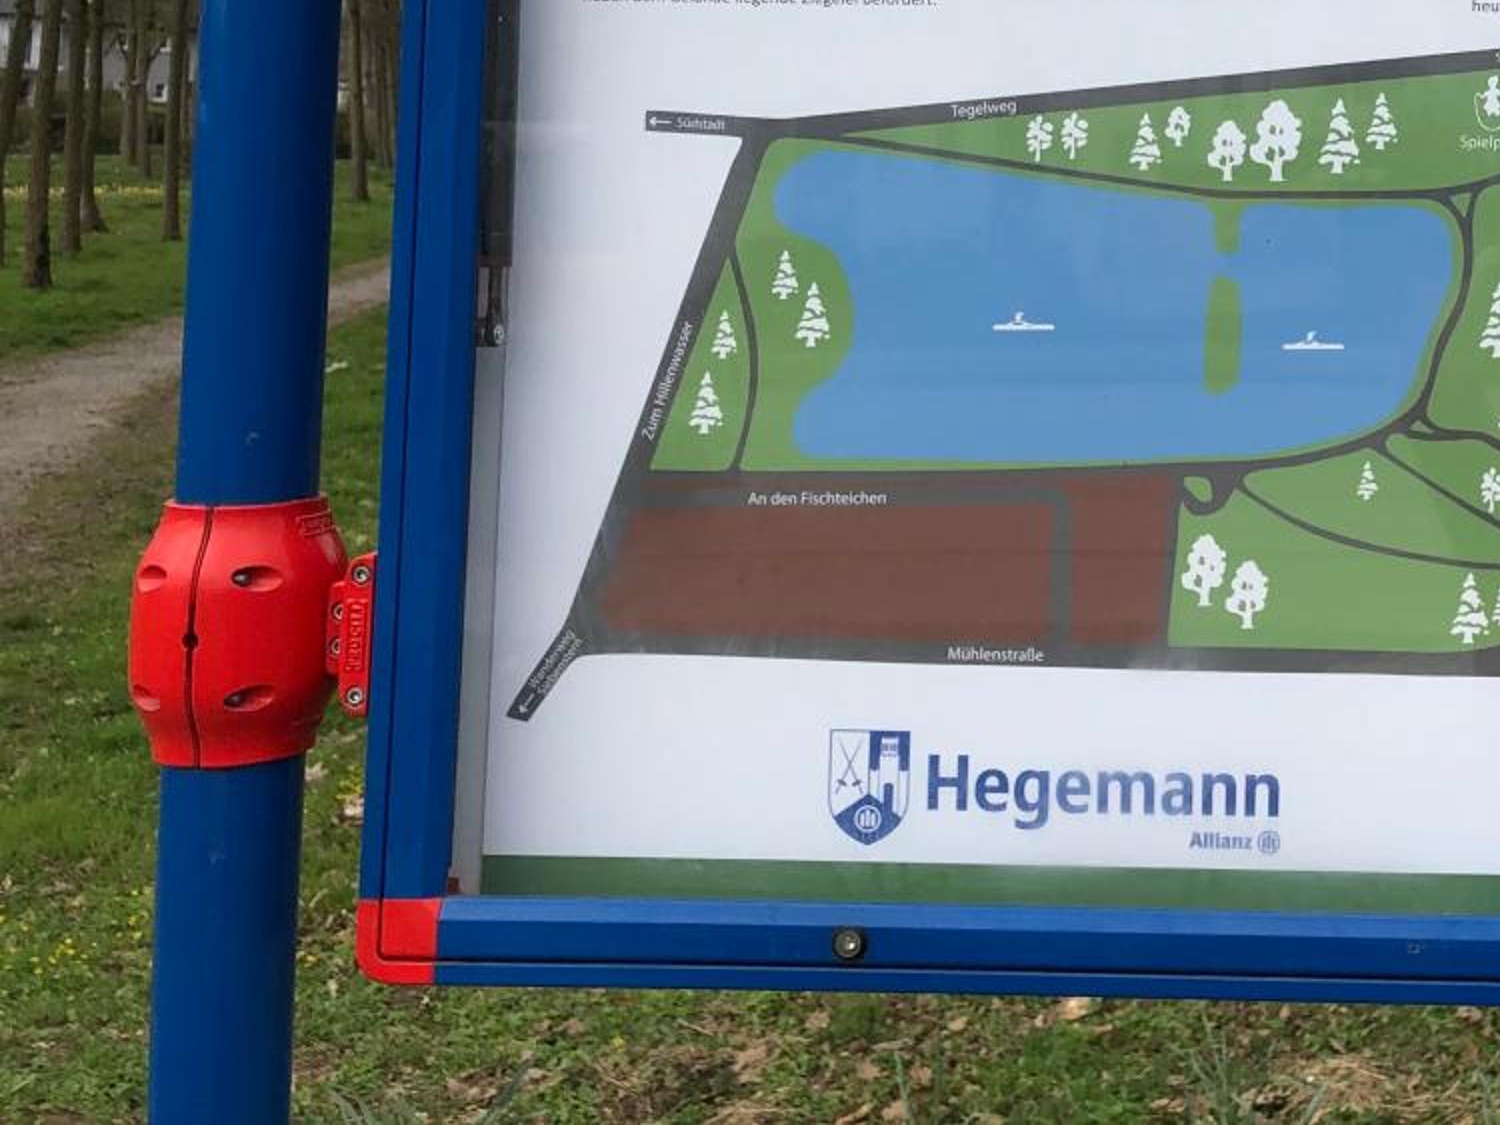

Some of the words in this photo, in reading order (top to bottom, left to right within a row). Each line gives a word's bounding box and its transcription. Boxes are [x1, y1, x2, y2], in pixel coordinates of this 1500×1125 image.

[950, 101, 1016, 120] Tegelweg
[747, 492, 767, 505] An
[770, 491, 798, 506] den
[801, 490, 887, 506] Fischteichen
[947, 646, 1045, 662] Mühlenstraße
[927, 754, 1280, 830] Hegemann
[1189, 831, 1254, 851] Allianz
